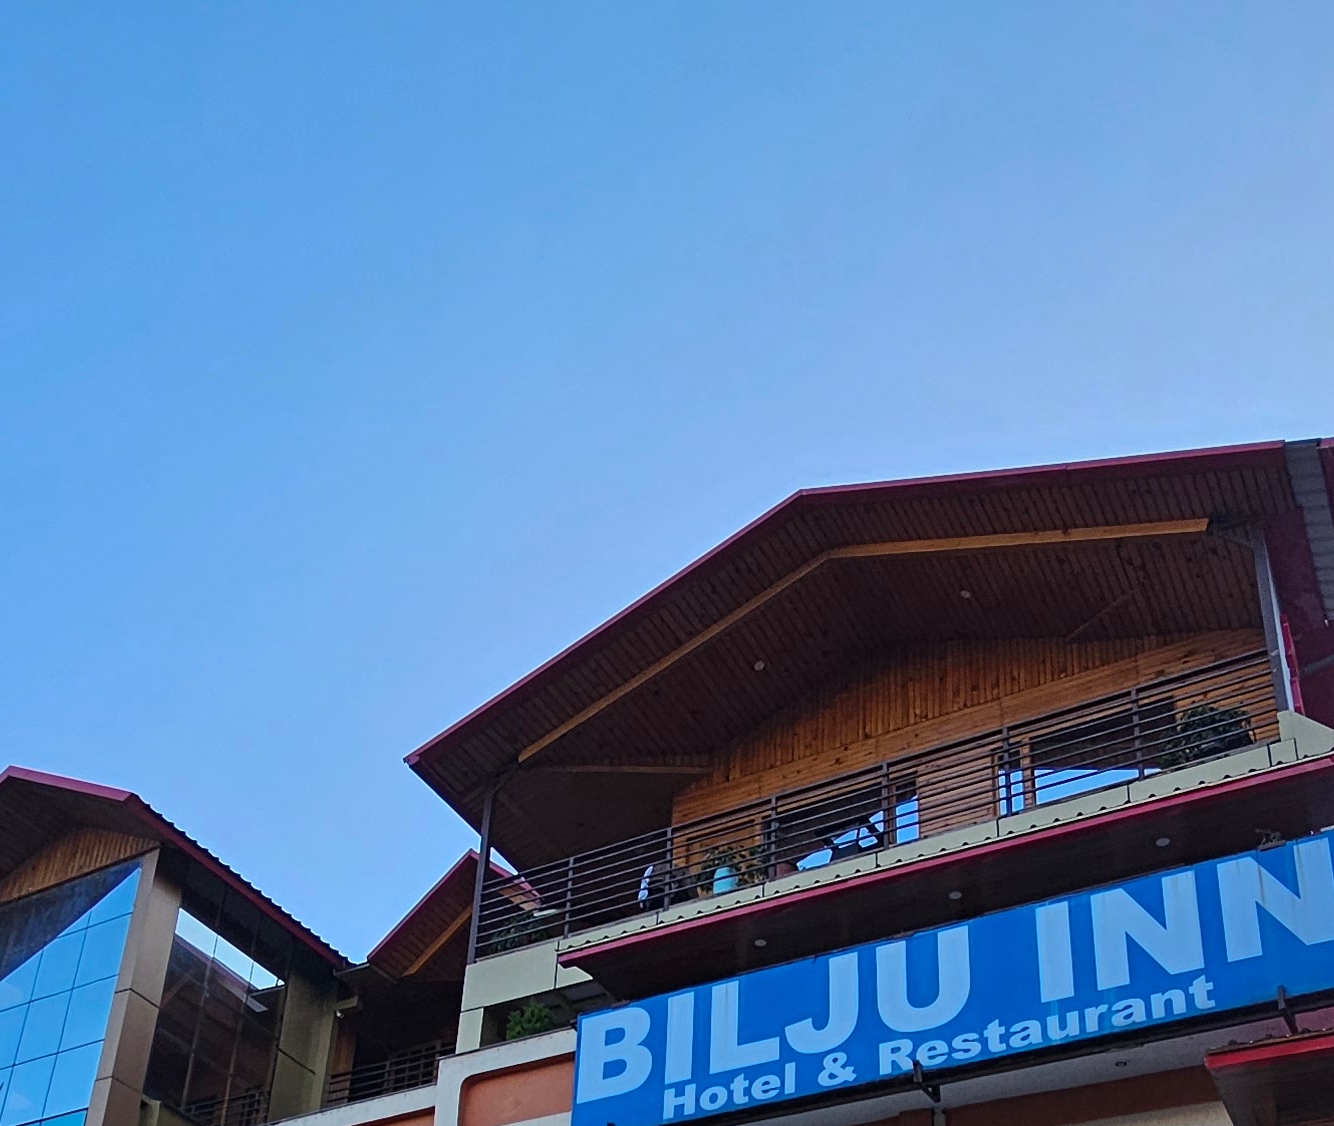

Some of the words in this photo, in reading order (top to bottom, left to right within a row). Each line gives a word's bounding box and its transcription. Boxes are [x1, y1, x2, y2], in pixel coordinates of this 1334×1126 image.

[576, 925, 971, 1105] BILJU
[663, 1062, 796, 1120] Hotel
[817, 1052, 857, 1087] &
[879, 974, 1216, 1076] Restaurant
